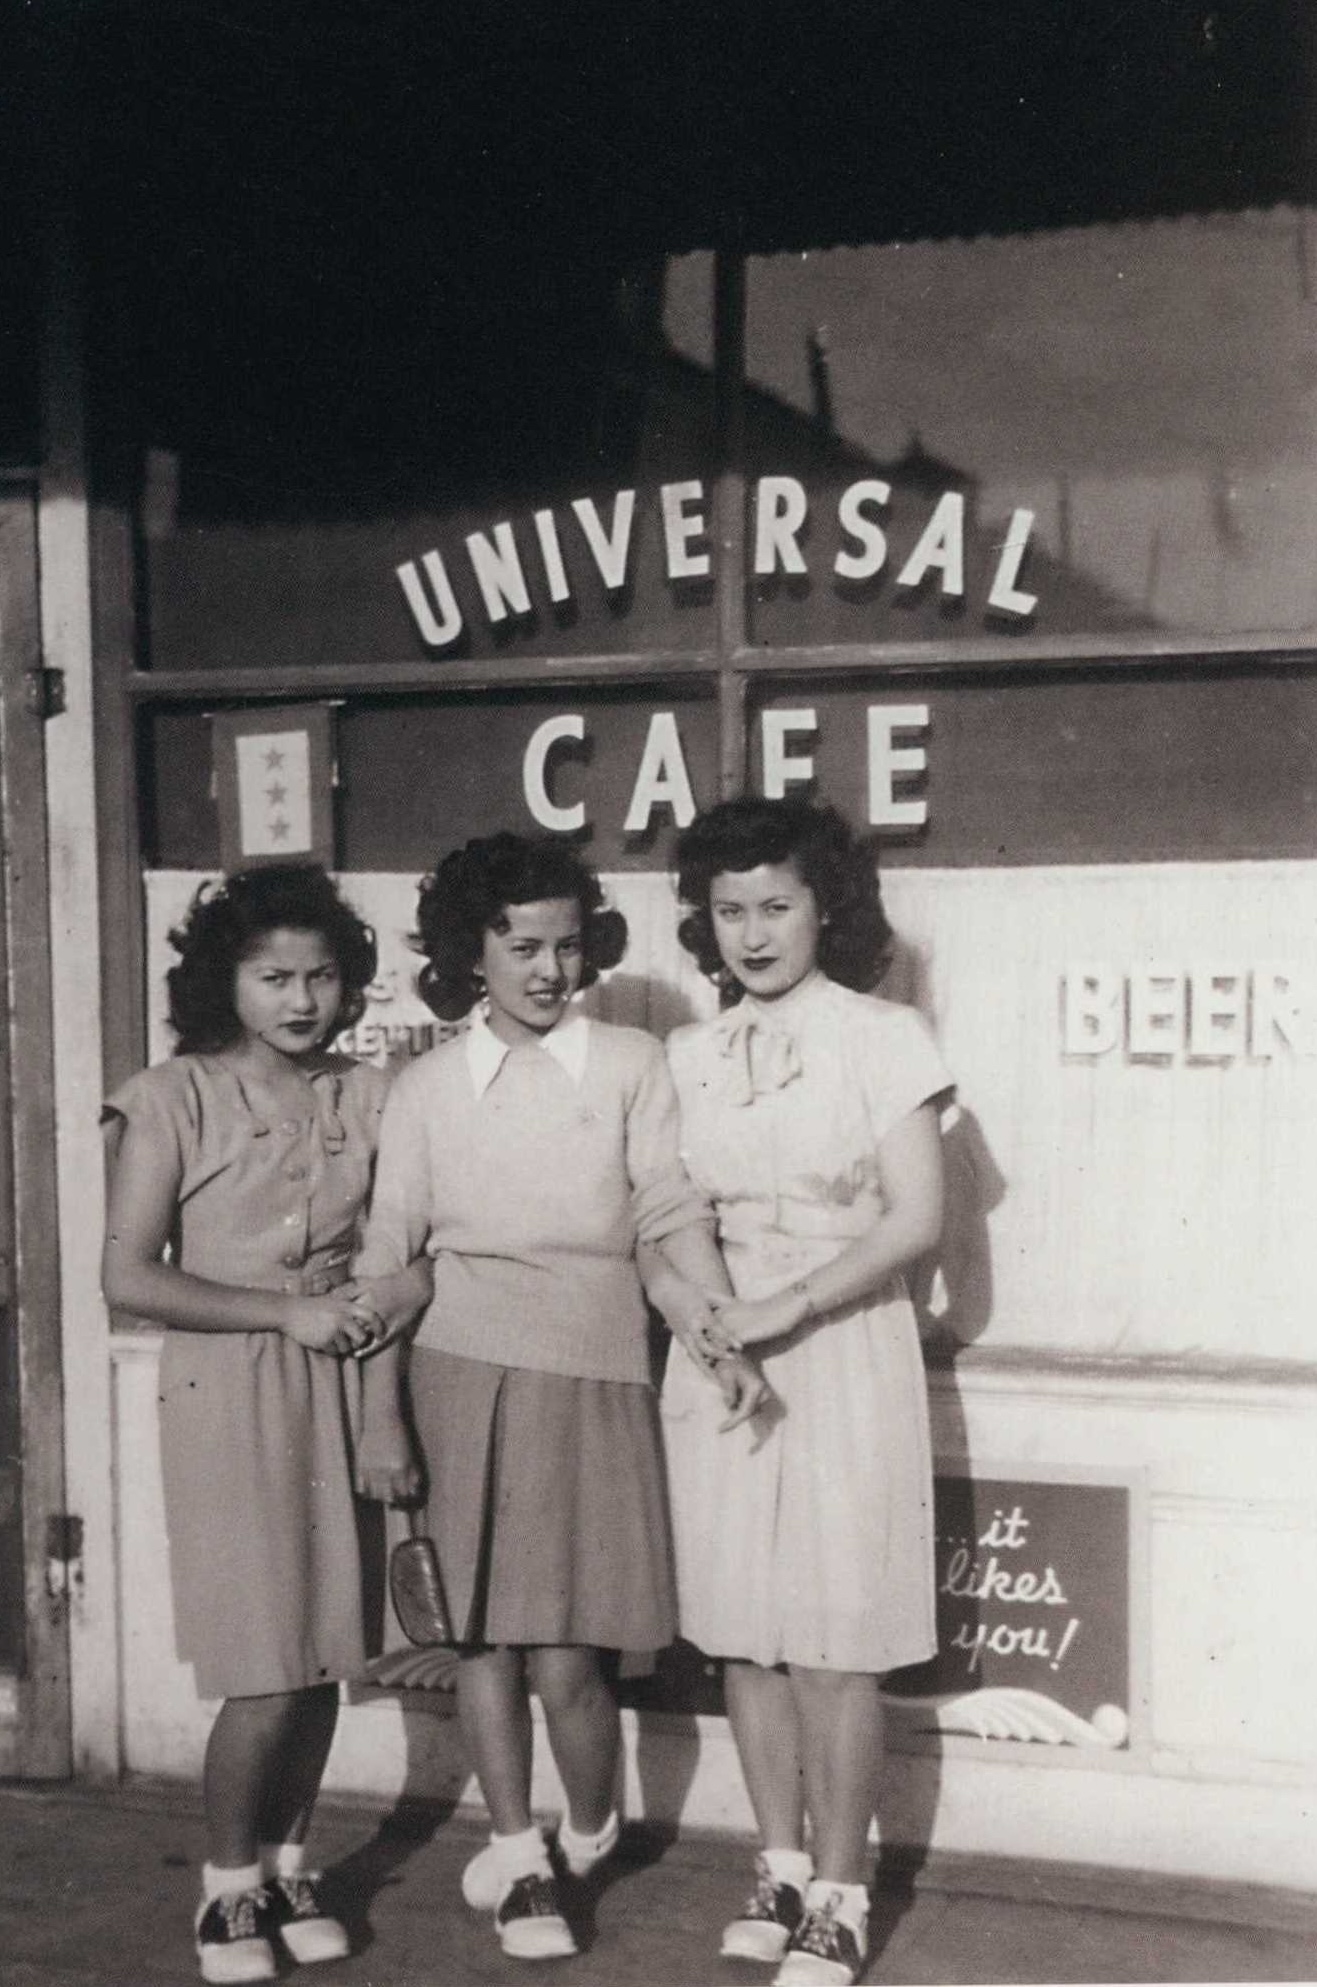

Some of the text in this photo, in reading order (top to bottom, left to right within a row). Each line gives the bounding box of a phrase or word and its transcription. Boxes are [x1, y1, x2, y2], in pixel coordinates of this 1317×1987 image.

[397, 475, 1039, 646] UNIVERSAL
[522, 703, 930, 831] CAFE
[1058, 962, 1315, 1068] BEER
[940, 1548, 1068, 1604] likes
[951, 1617, 1080, 1673] you!
